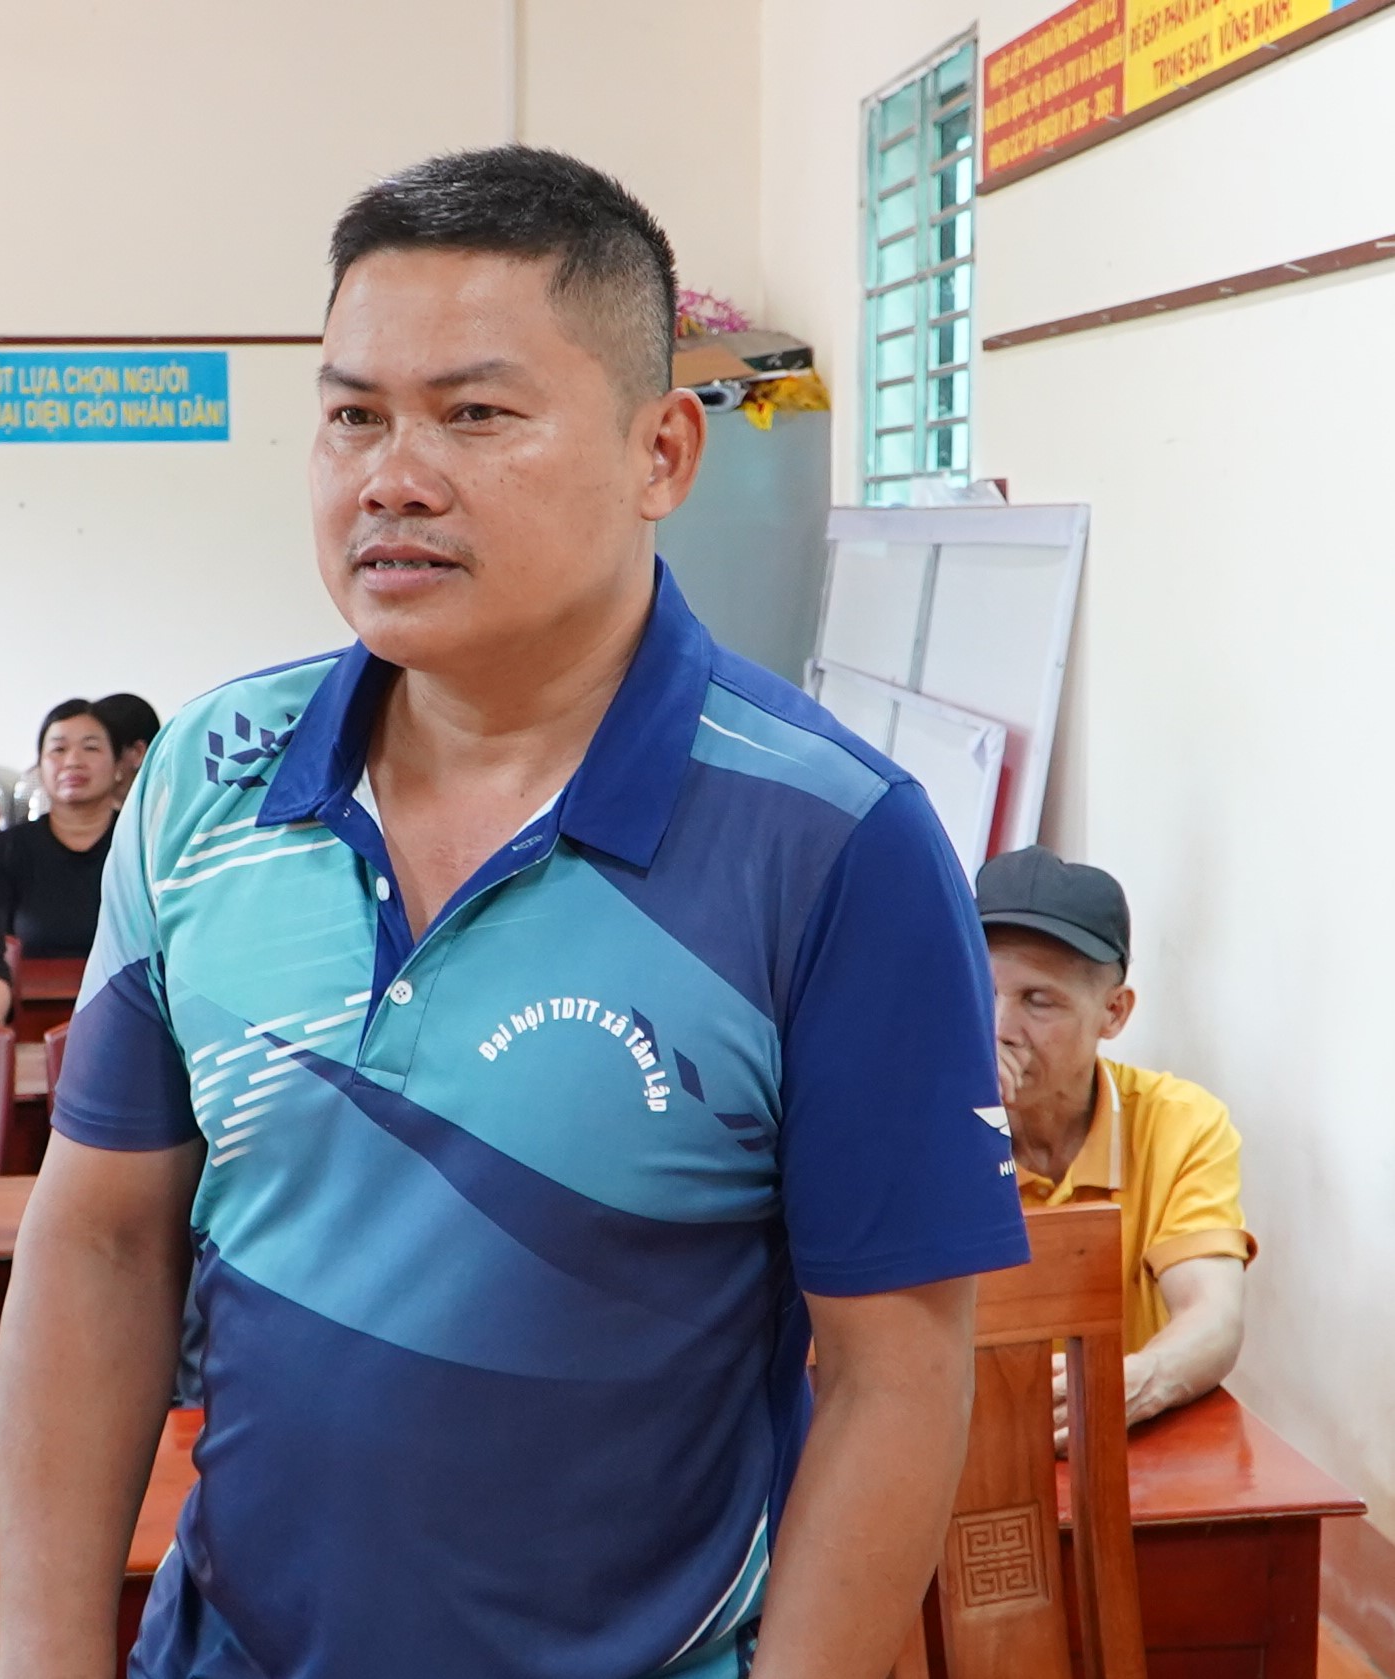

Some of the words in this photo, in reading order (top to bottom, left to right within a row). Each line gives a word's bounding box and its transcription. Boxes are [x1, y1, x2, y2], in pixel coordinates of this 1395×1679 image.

[19, 366, 60, 399] LỰA
[64, 365, 119, 399] CHỌN
[123, 359, 189, 393] NGƯỜI
[25, 399, 70, 433] DIỆN
[74, 401, 117, 428] CHO
[121, 394, 174, 427] NHÂN
[478, 1024, 513, 1062] Đại
[510, 1002, 545, 1034] hội
[549, 997, 600, 1022] TDTT
[599, 1009, 629, 1037] xã
[625, 1027, 657, 1070] Tân
[643, 1071, 671, 1112] Lập
